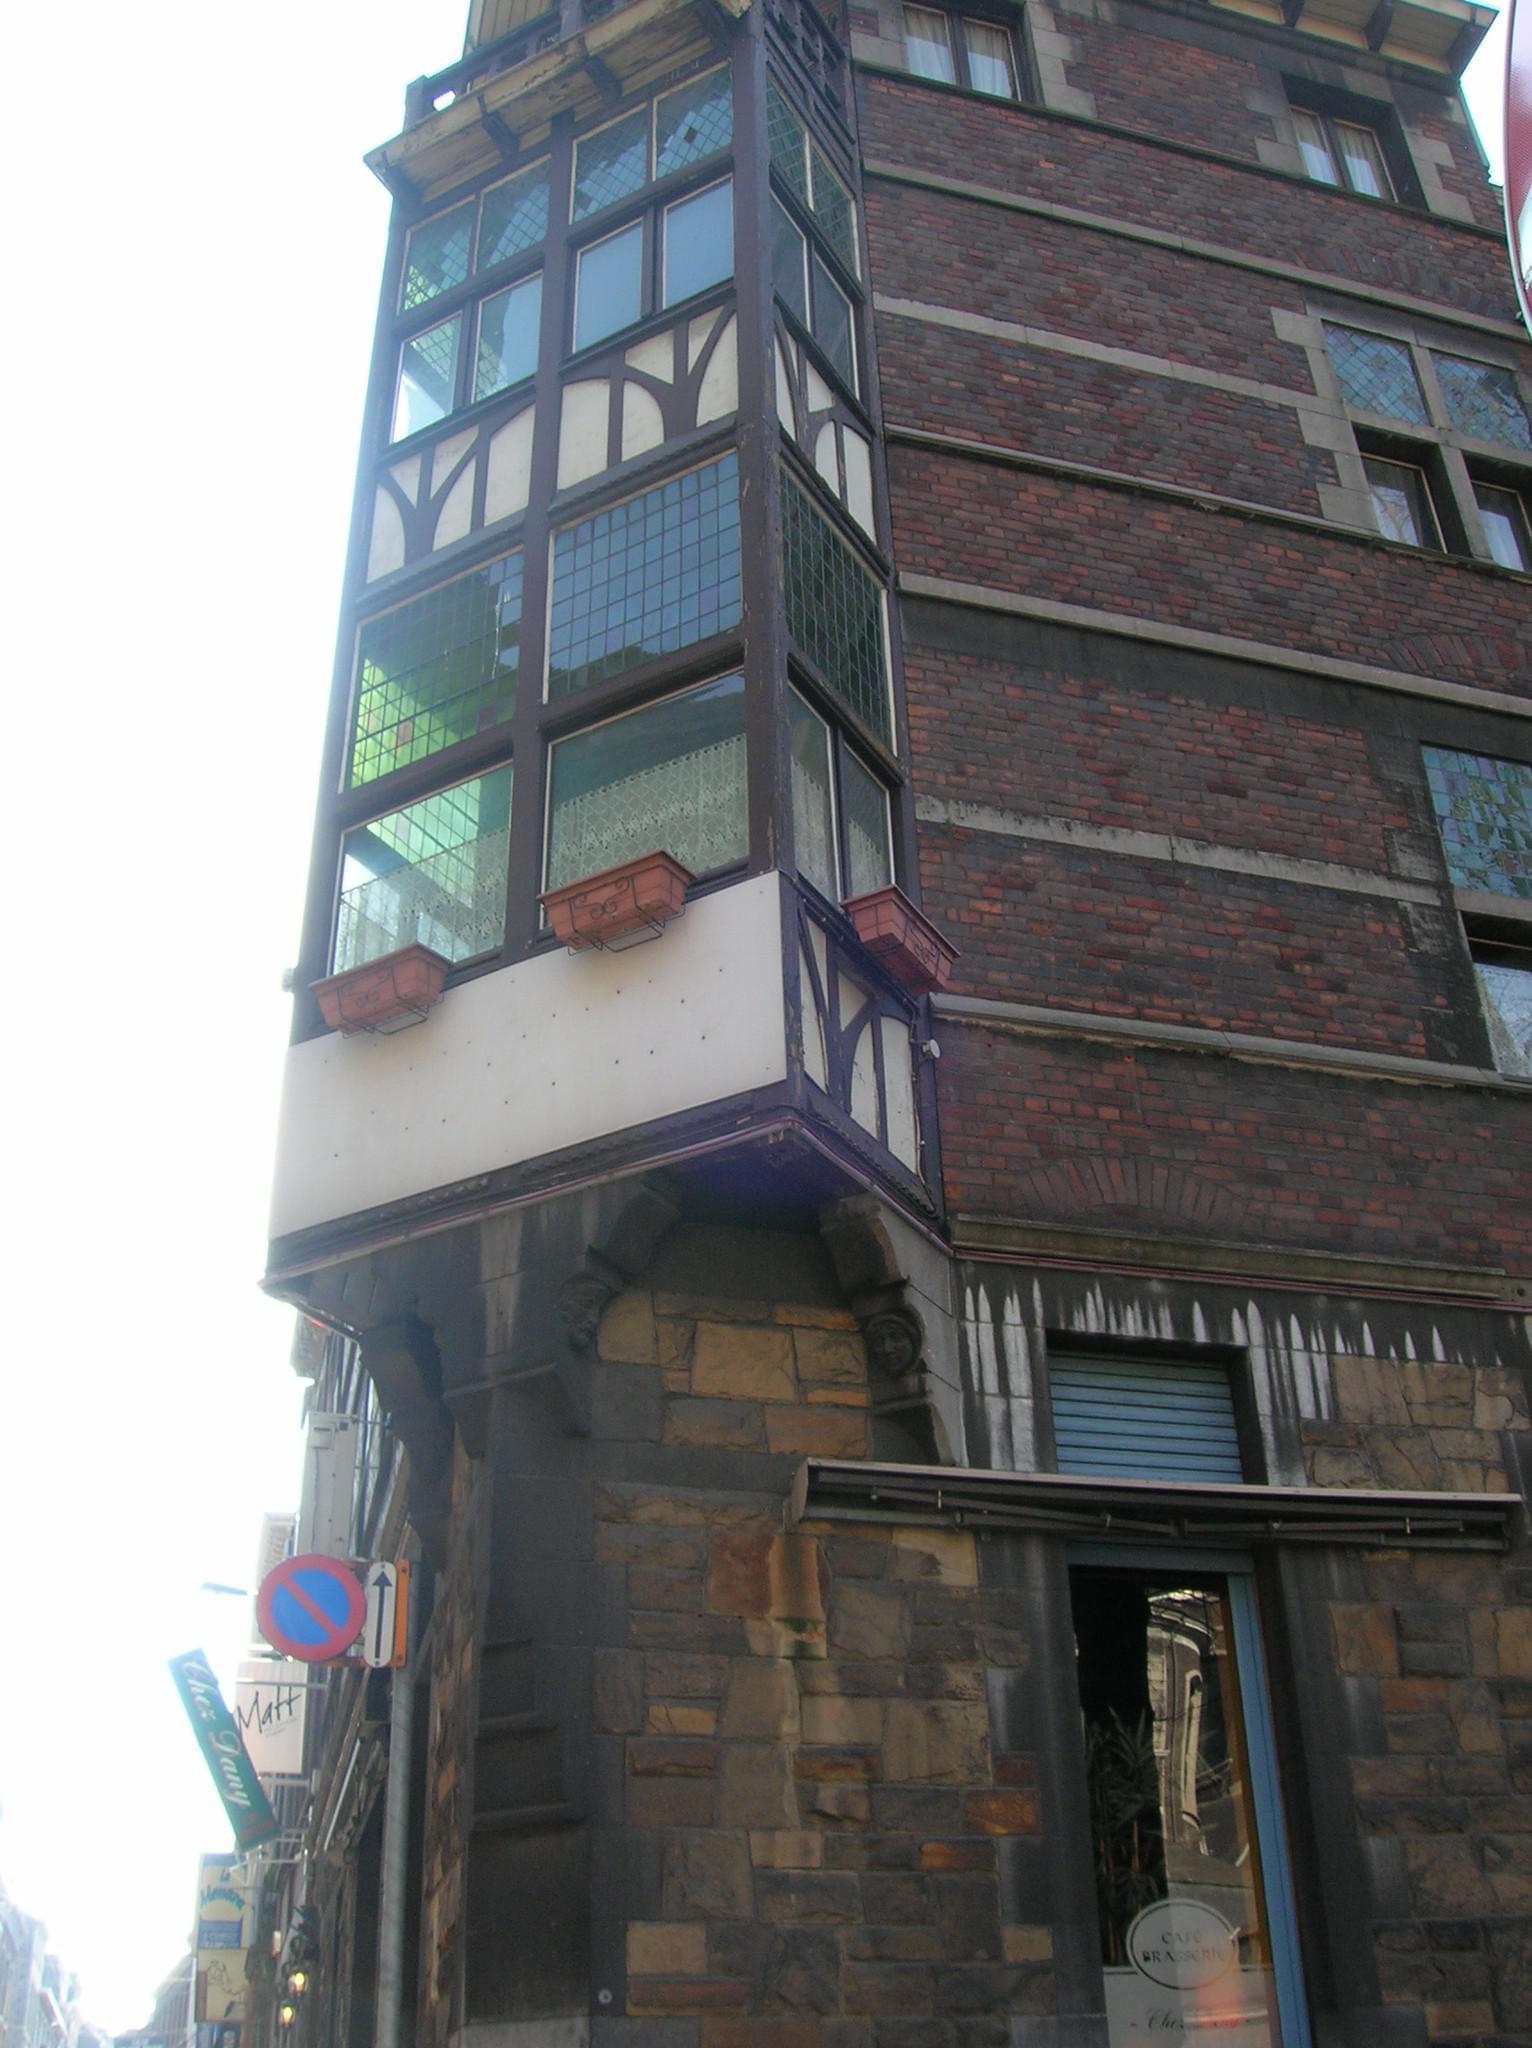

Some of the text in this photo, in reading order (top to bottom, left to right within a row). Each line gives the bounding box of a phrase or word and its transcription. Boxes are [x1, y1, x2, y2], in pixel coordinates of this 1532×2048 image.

[183, 1659, 251, 1806] Chez Dany
[237, 1685, 301, 1734] Matt
